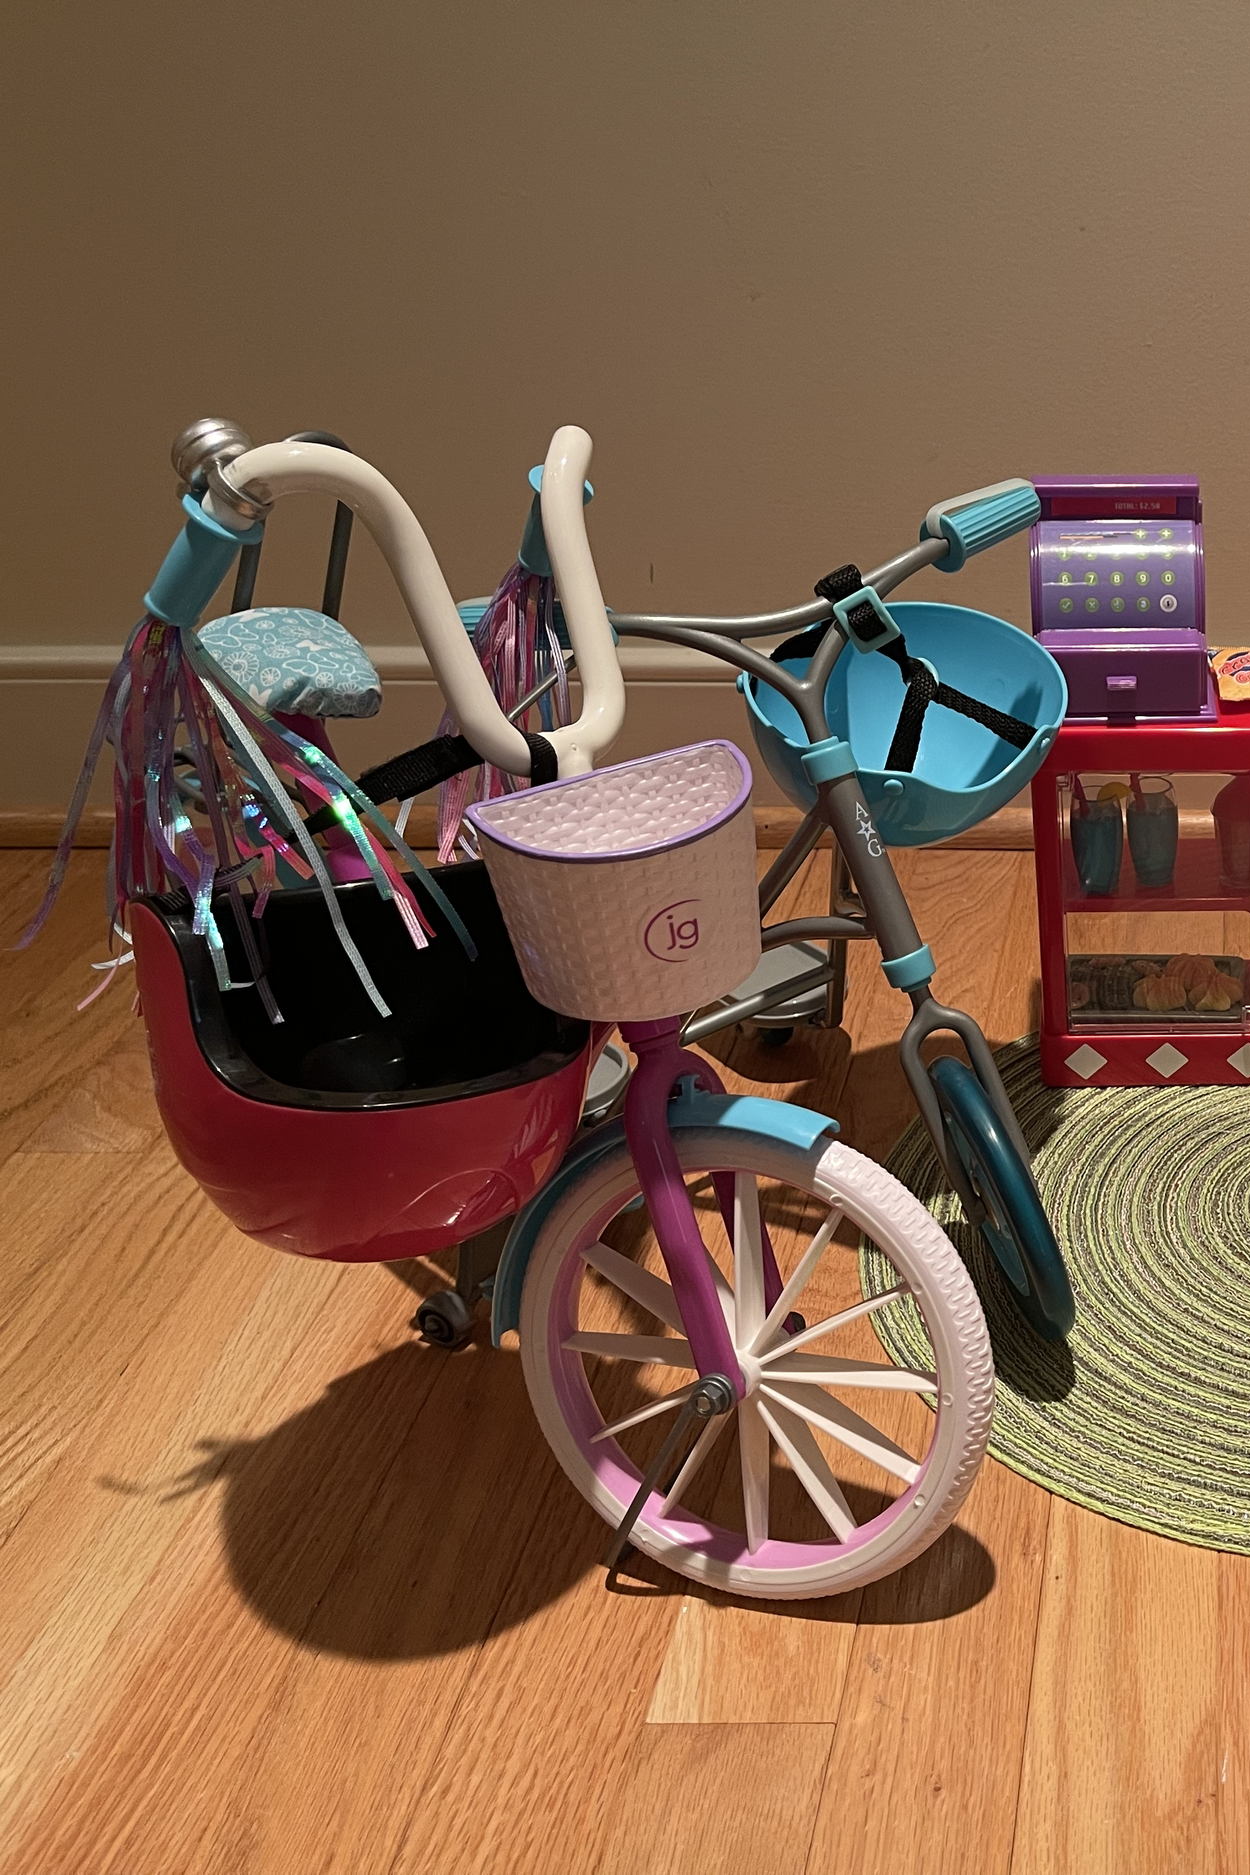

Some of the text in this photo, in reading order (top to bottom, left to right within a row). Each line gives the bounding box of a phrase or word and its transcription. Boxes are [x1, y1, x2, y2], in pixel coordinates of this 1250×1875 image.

[1061, 574, 1069, 583] 6
[1088, 574, 1095, 584] 7
[1113, 574, 1120, 583] 8
[1139, 574, 1147, 583] 9
[666, 914, 699, 951] jg
